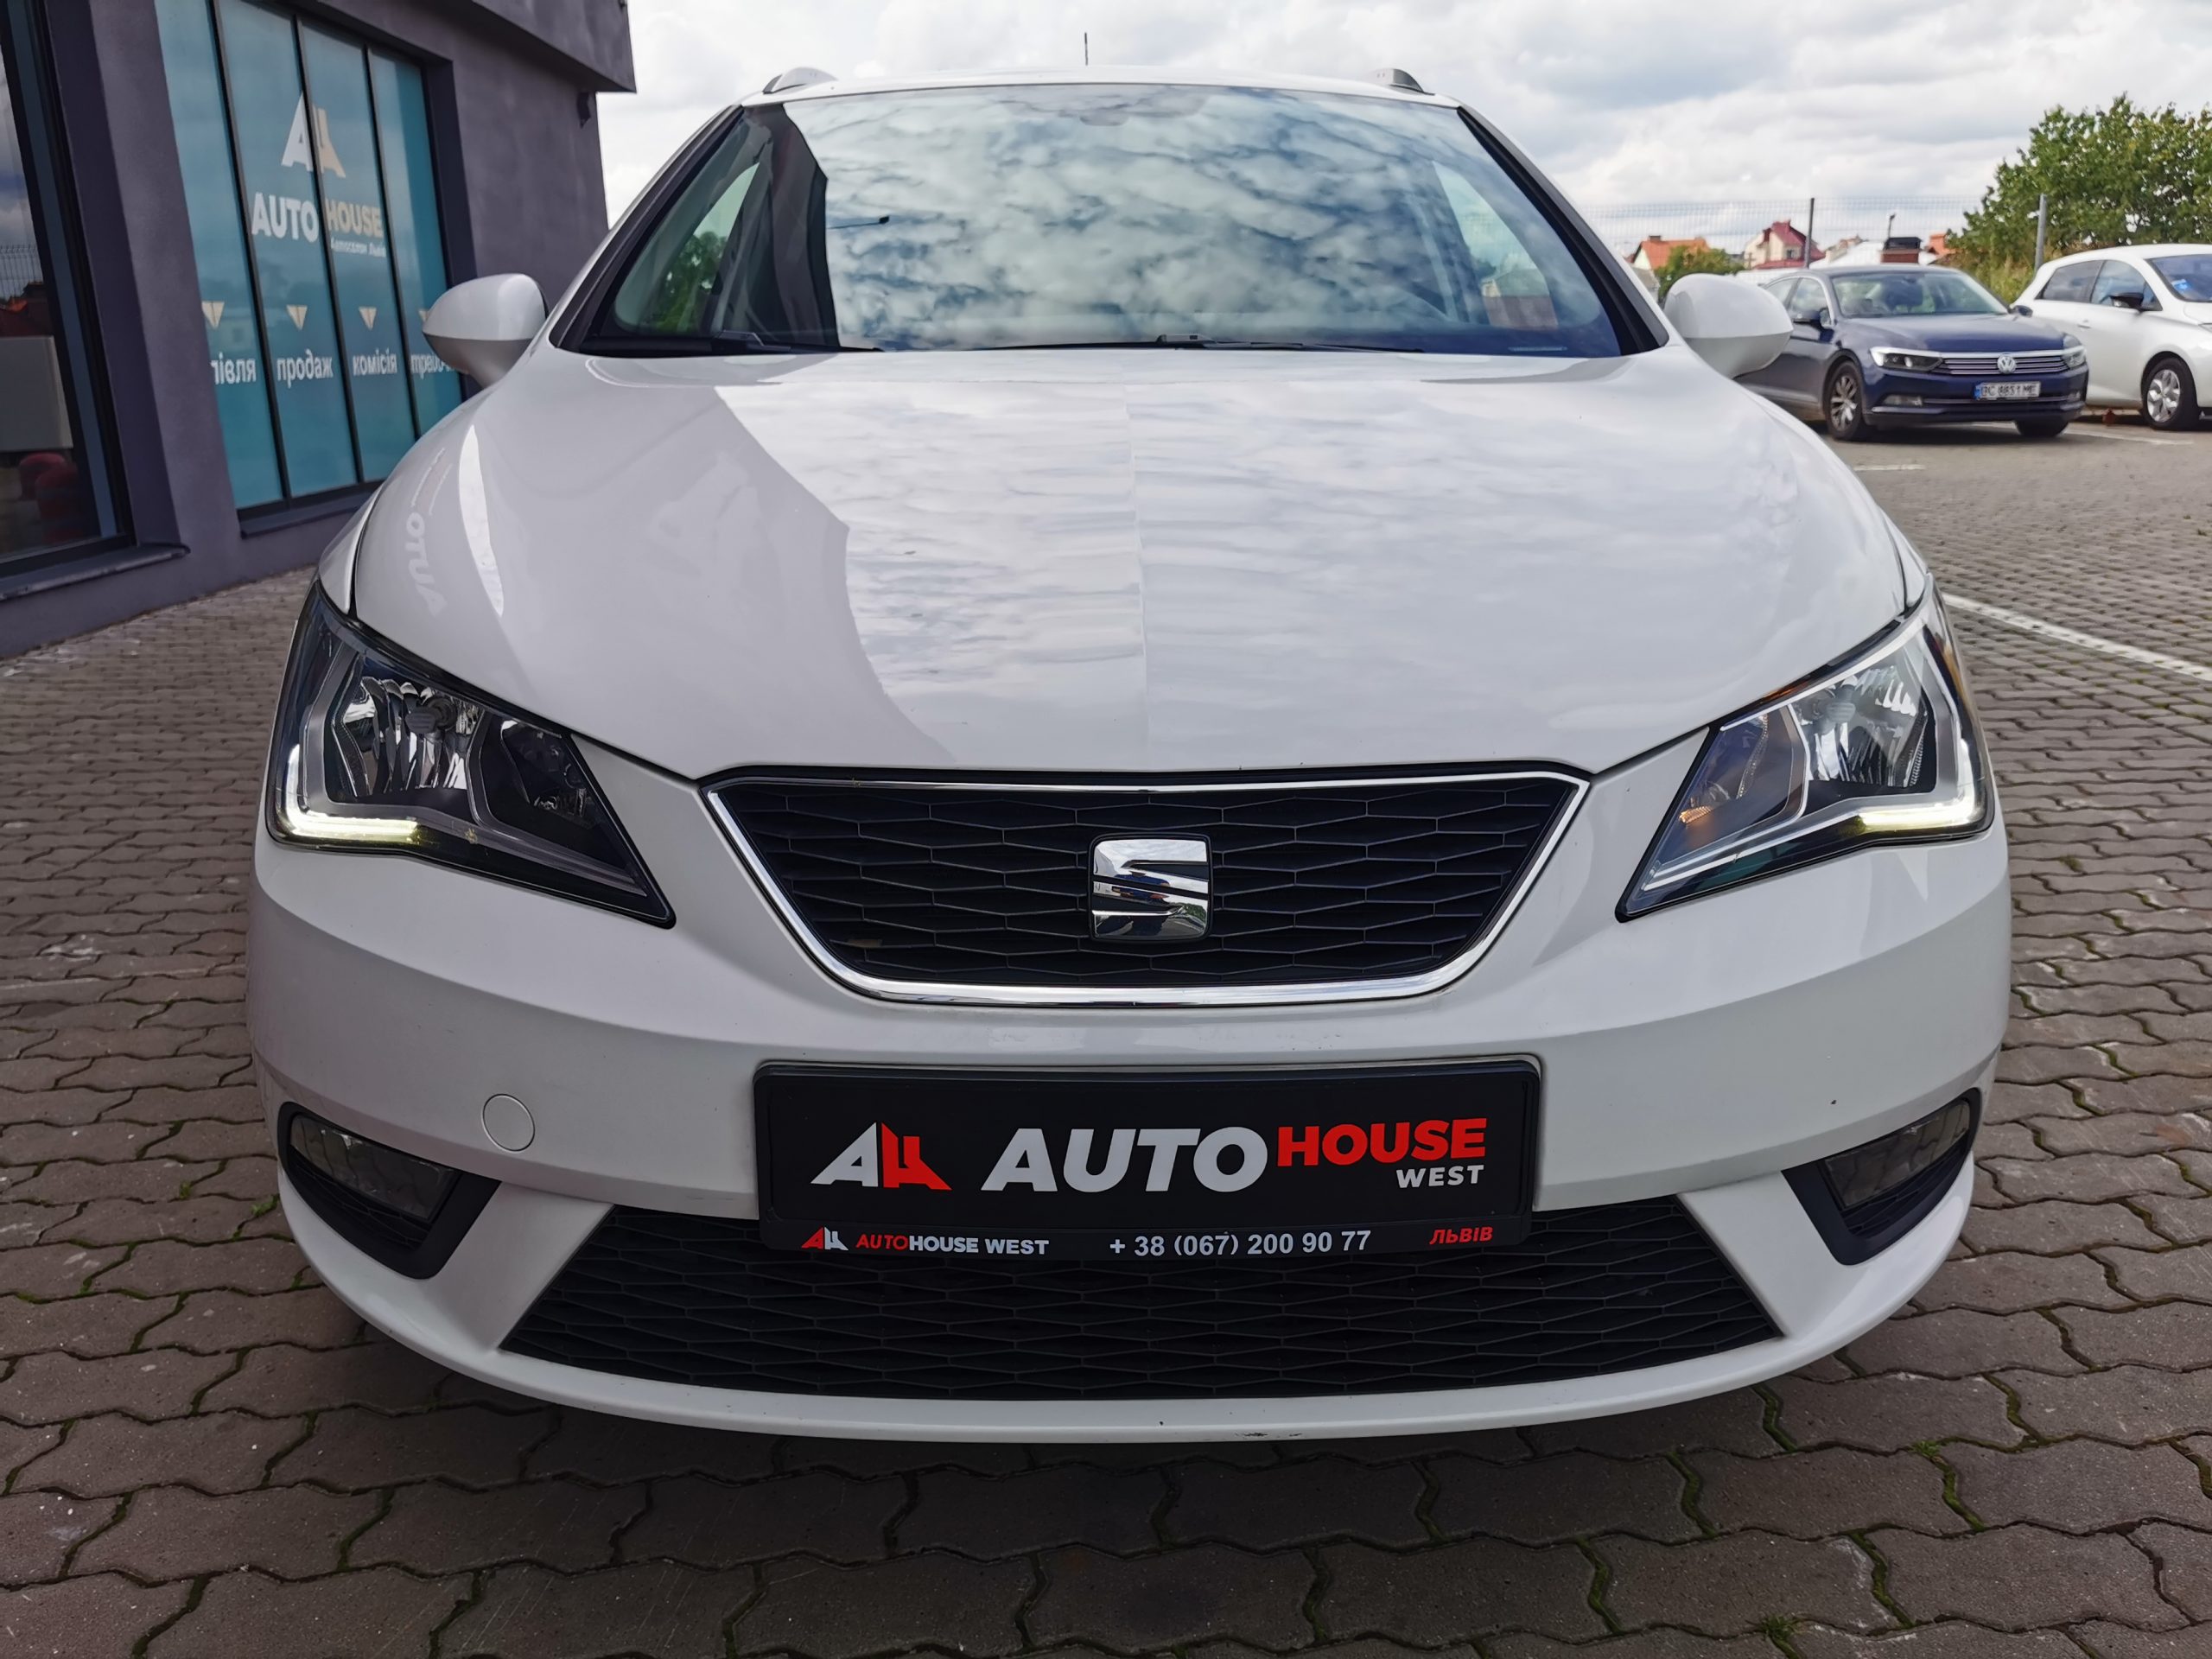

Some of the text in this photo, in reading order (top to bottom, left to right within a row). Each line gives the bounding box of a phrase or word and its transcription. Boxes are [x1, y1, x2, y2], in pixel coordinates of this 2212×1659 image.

[251, 192, 384, 243] AUTO HOUSE
[276, 348, 334, 389] продаж
[353, 347, 397, 376] комісія
[981, 1118, 1487, 1192] AUTO HOUSE
[1396, 1165, 1484, 1189] WEST
[855, 1234, 979, 1254] AUTOHOUSE
[984, 1238, 1050, 1255] WEST
[1134, 1235, 1165, 1256] 38
[1173, 1233, 1239, 1256] (067)
[1247, 1233, 1294, 1255] 200
[1301, 1231, 1332, 1253] 90
[1341, 1230, 1372, 1251] 77
[1428, 1225, 1494, 1246] ЛЬВІВ
